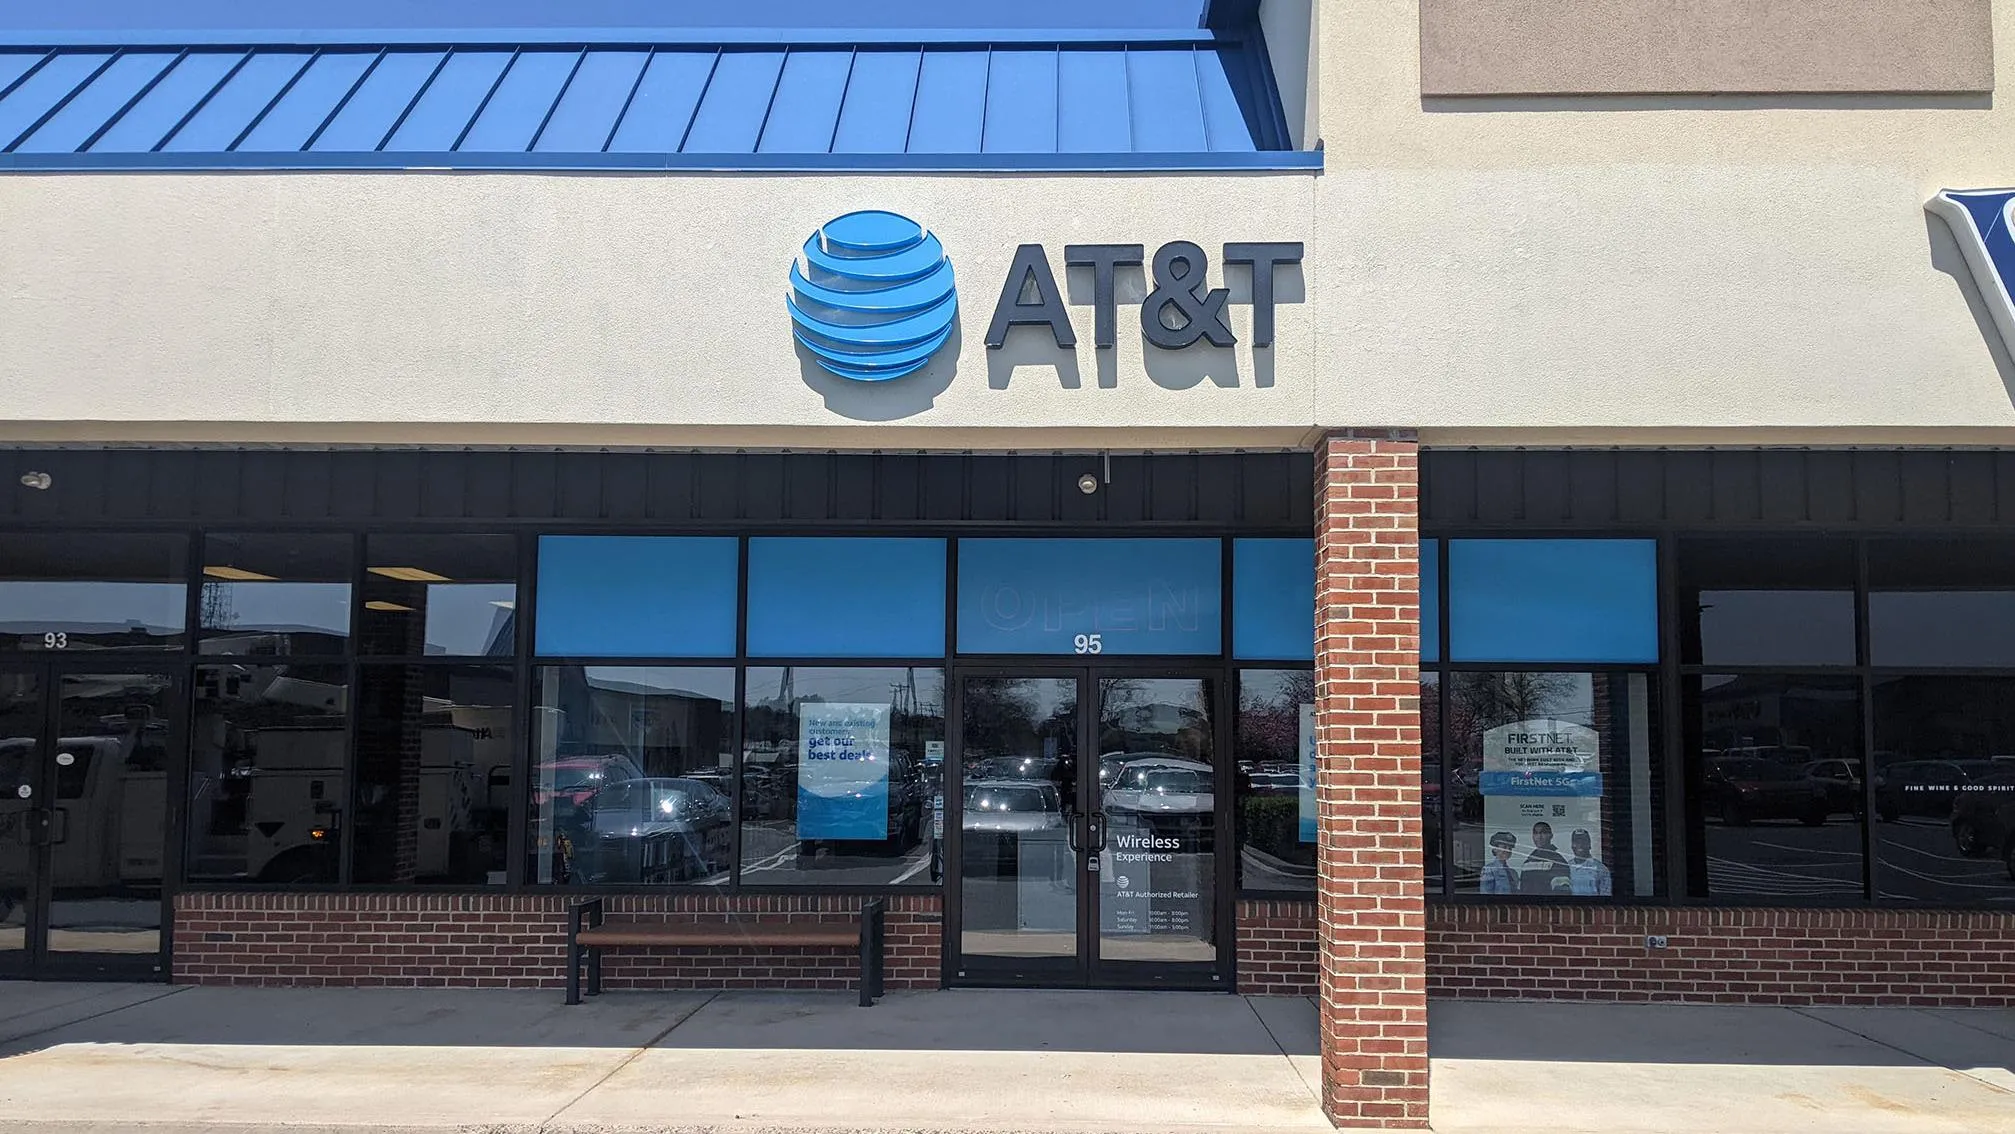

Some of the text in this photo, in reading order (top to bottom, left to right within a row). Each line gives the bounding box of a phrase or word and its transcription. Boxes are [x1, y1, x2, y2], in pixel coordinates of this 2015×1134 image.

[984, 240, 1304, 349] AT&T
[981, 583, 1198, 631] OPEN
[44, 632, 67, 648] 93
[1074, 634, 1101, 654] 95
[809, 737, 854, 748] get our
[808, 749, 836, 760] best
[1554, 746, 1578, 755] AT&T
[1511, 776, 1570, 786] FirstNet 5G
[1116, 834, 1180, 849] Wireless
[1116, 852, 1172, 863] Experience
